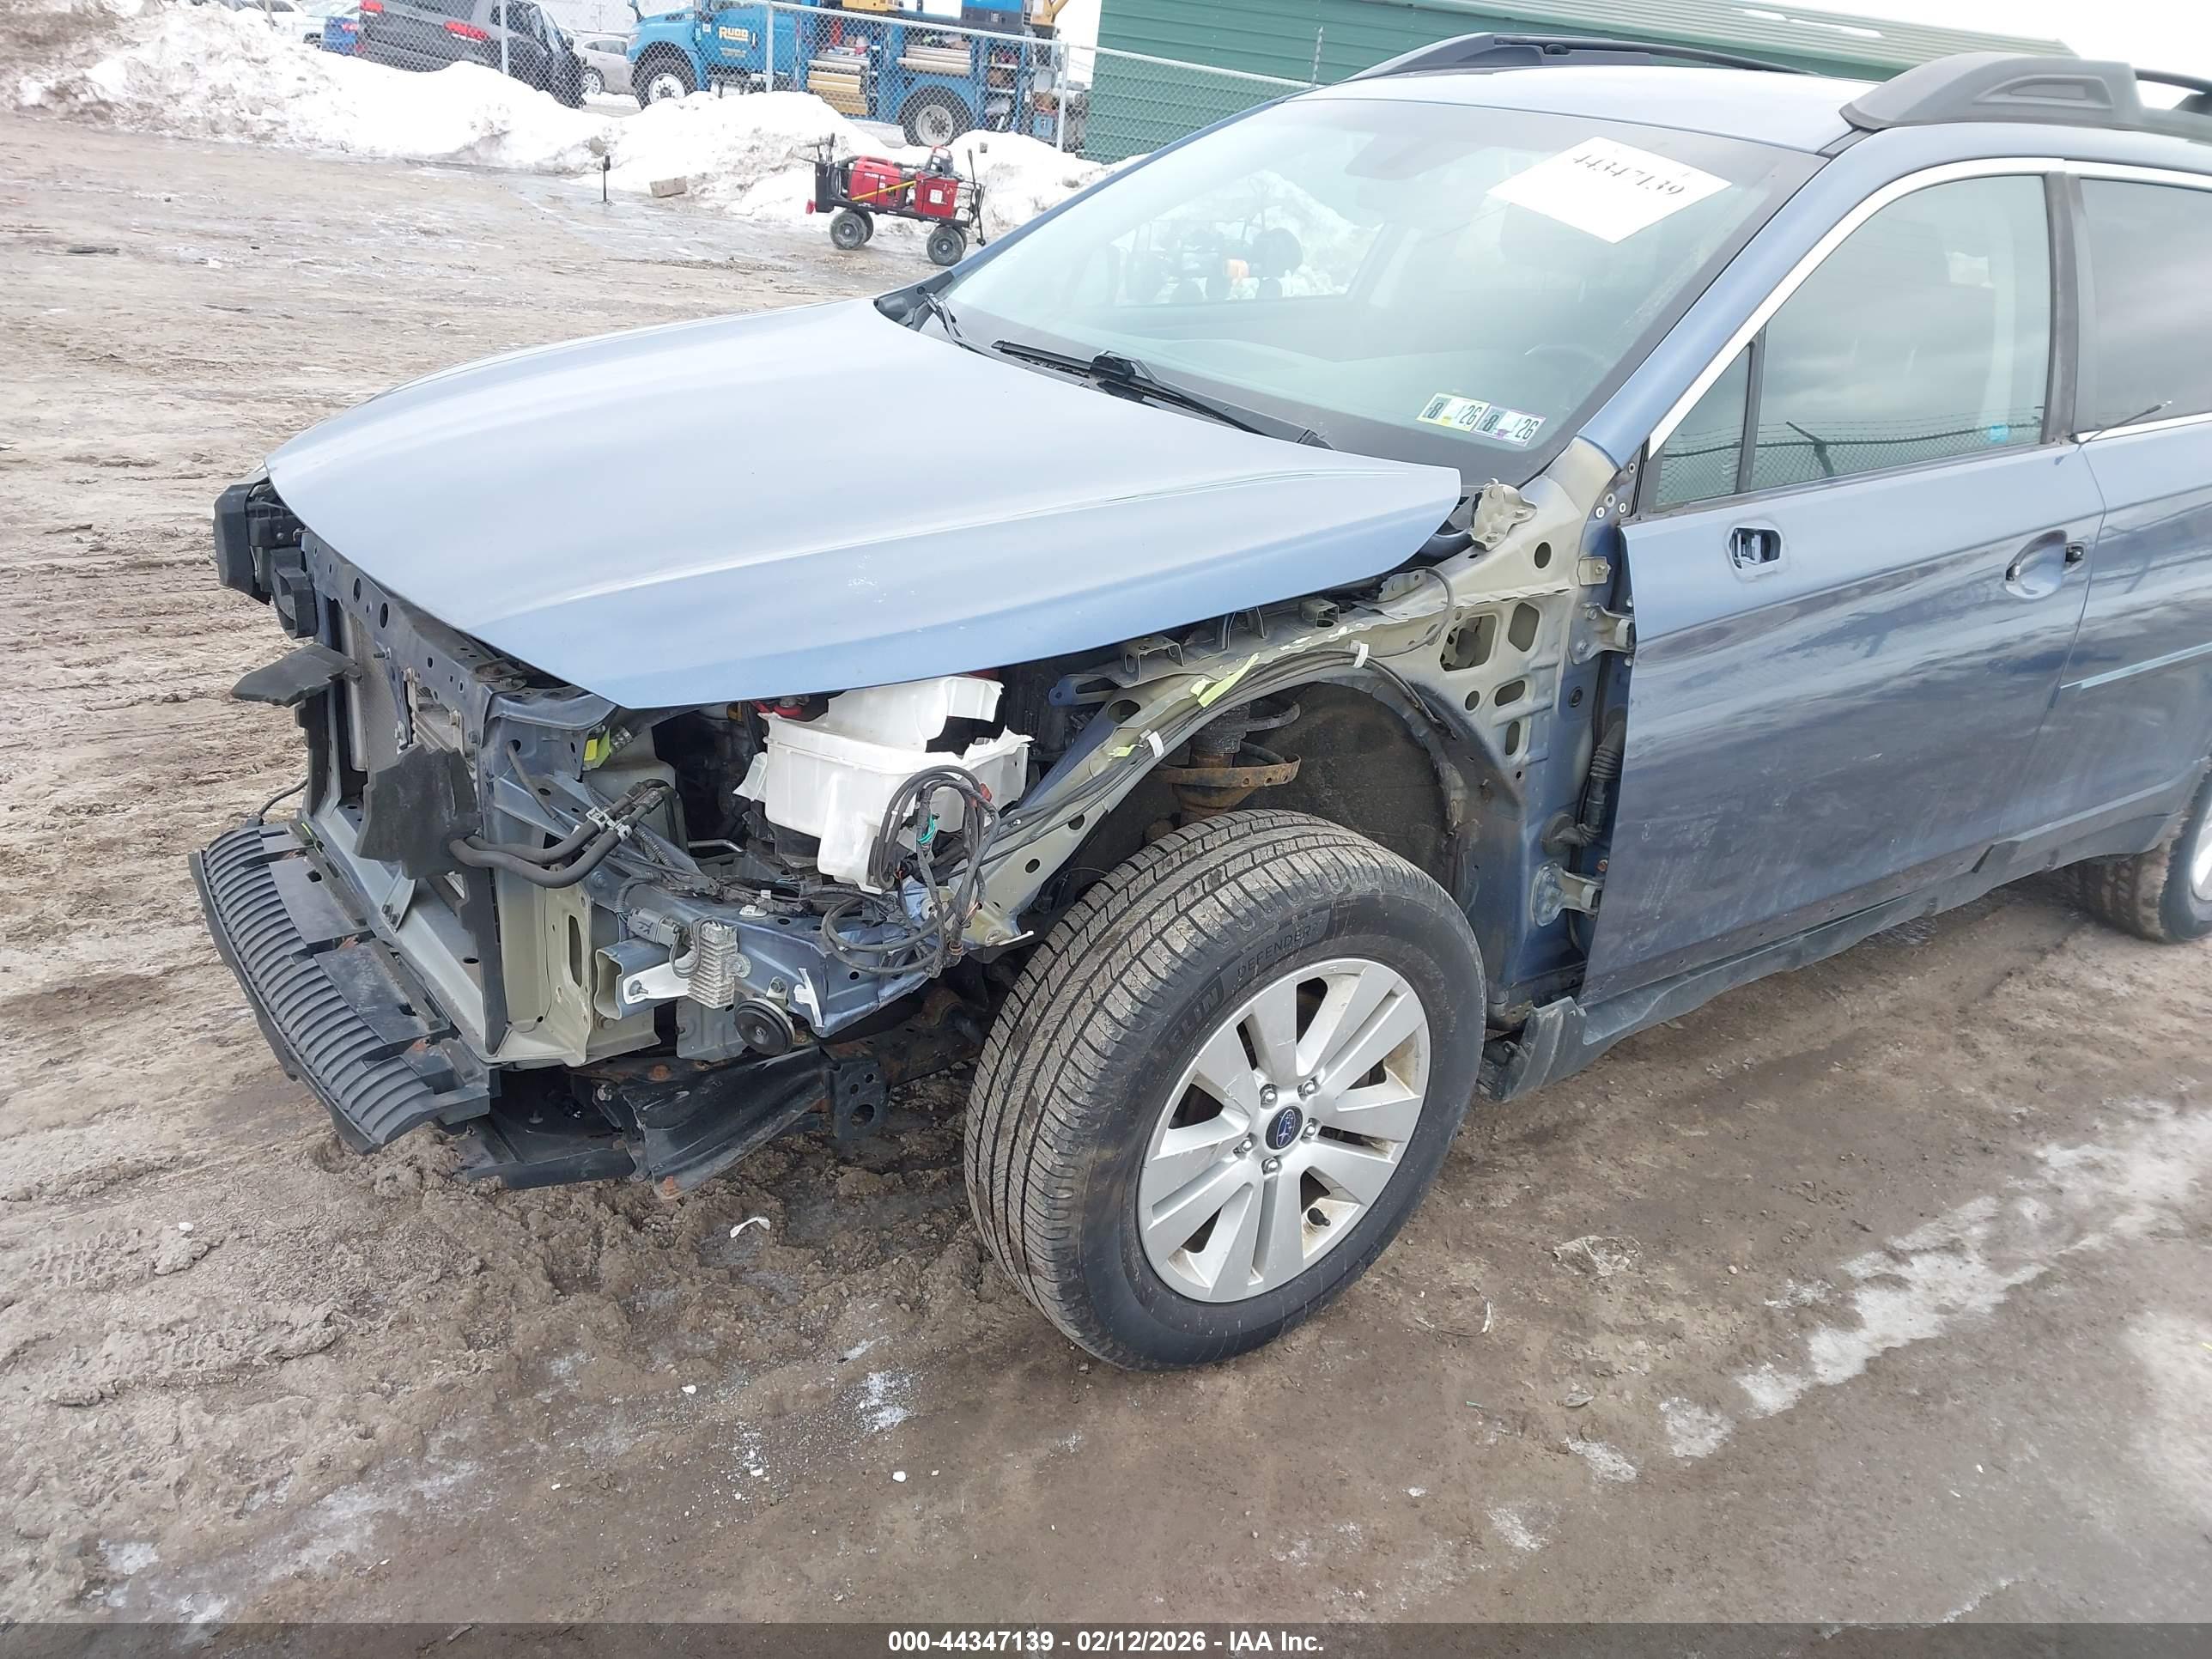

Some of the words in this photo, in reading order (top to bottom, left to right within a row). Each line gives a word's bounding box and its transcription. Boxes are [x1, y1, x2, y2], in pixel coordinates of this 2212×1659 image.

[1427, 402, 1444, 419] 8
[1459, 404, 1483, 426] 26
[1482, 414, 1499, 432] 8
[1515, 418, 1540, 440] 26
